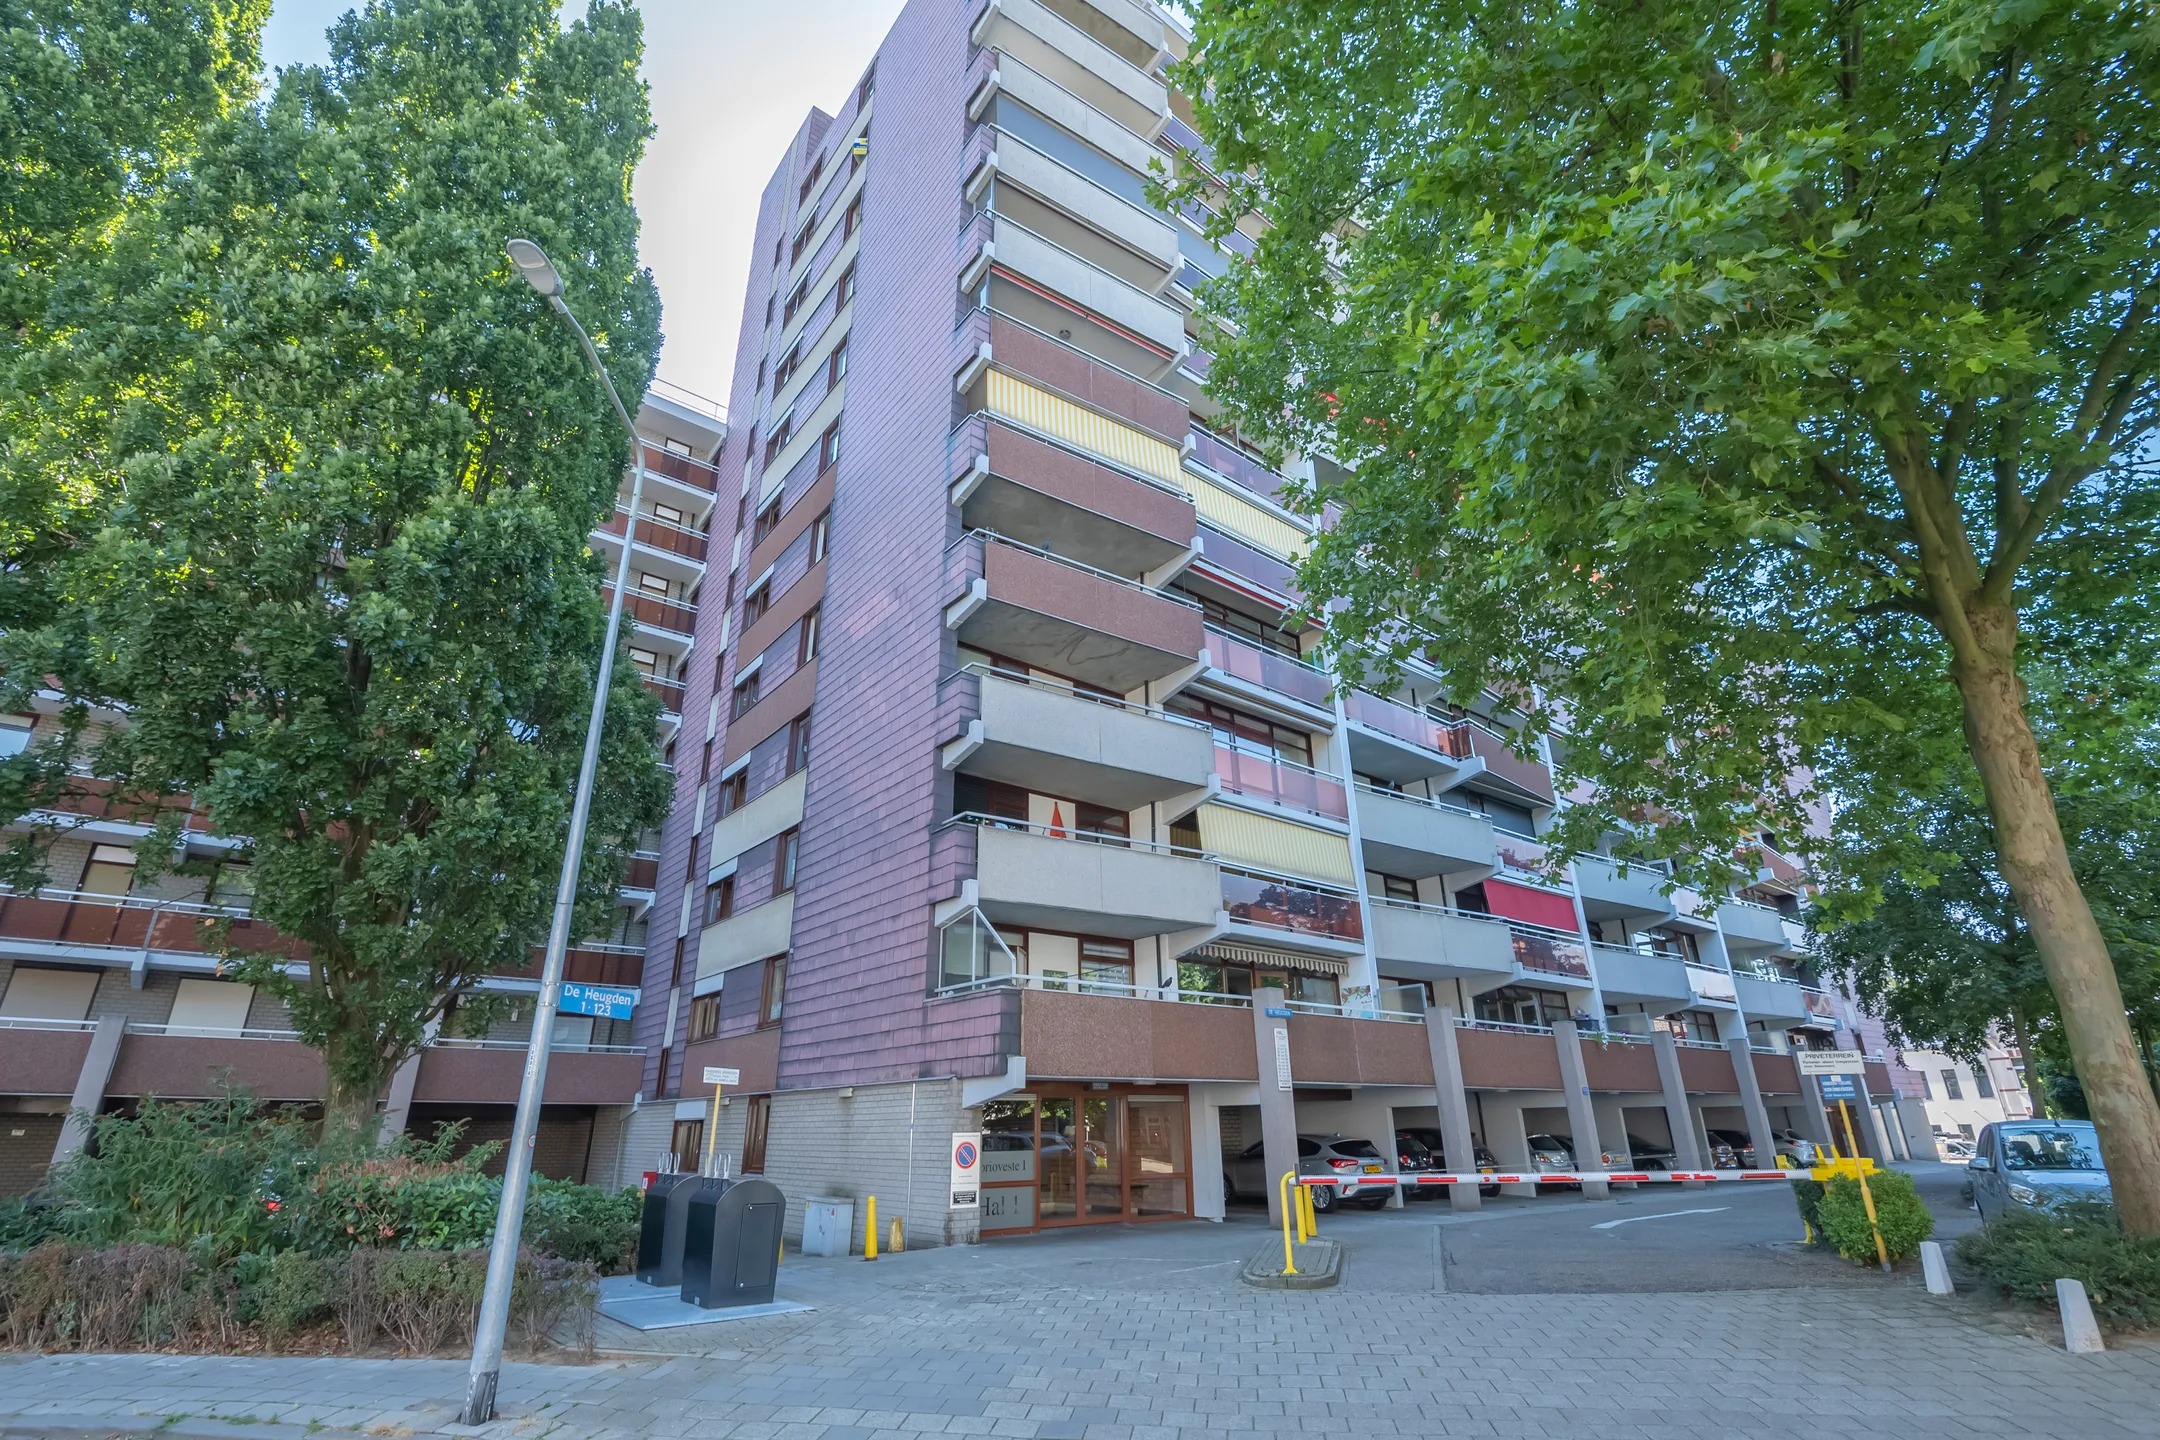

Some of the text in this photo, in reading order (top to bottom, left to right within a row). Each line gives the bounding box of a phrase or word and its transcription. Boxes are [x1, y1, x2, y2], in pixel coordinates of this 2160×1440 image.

[564, 984, 631, 1005] De Heugden
[581, 1001, 585, 1013] 1
[594, 1003, 611, 1016] 123
[980, 1196, 1005, 1216] Hal
